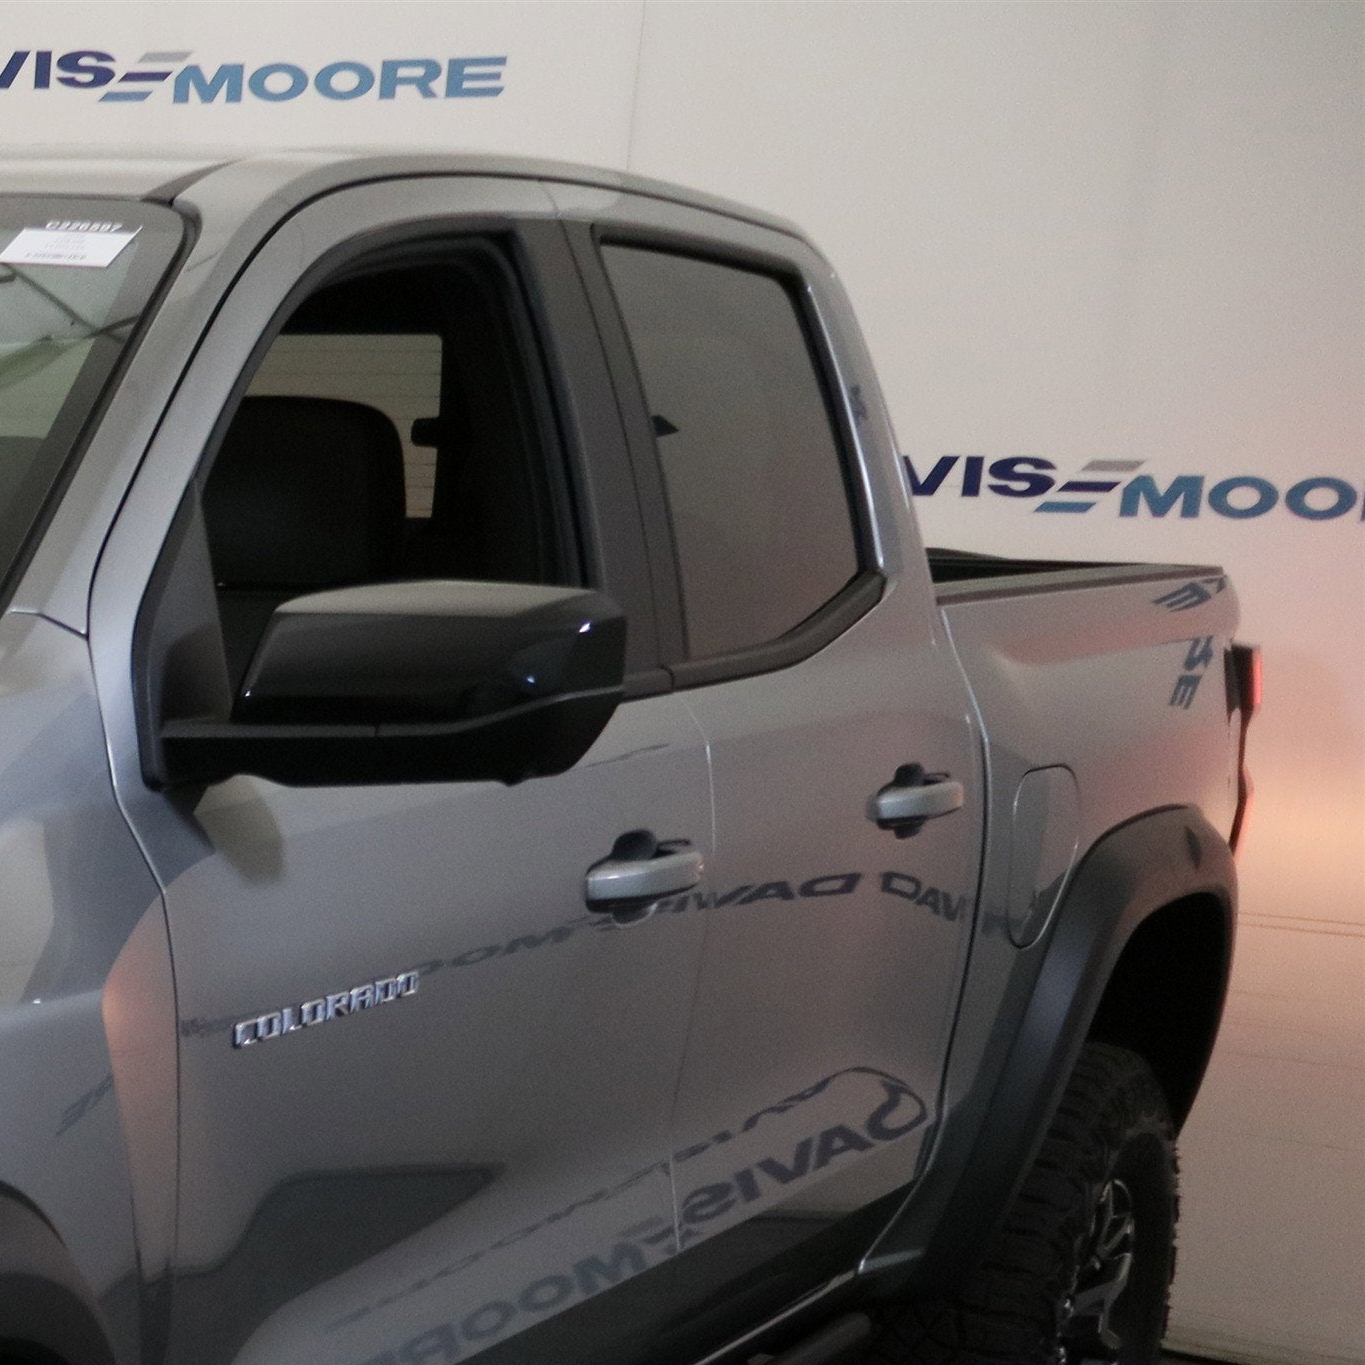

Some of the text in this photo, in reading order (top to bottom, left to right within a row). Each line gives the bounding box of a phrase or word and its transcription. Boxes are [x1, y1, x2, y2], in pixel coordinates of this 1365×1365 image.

[172, 56, 508, 104] MOORE
[901, 455, 1365, 521] VIS MOO
[233, 969, 420, 1049] COLORADO
